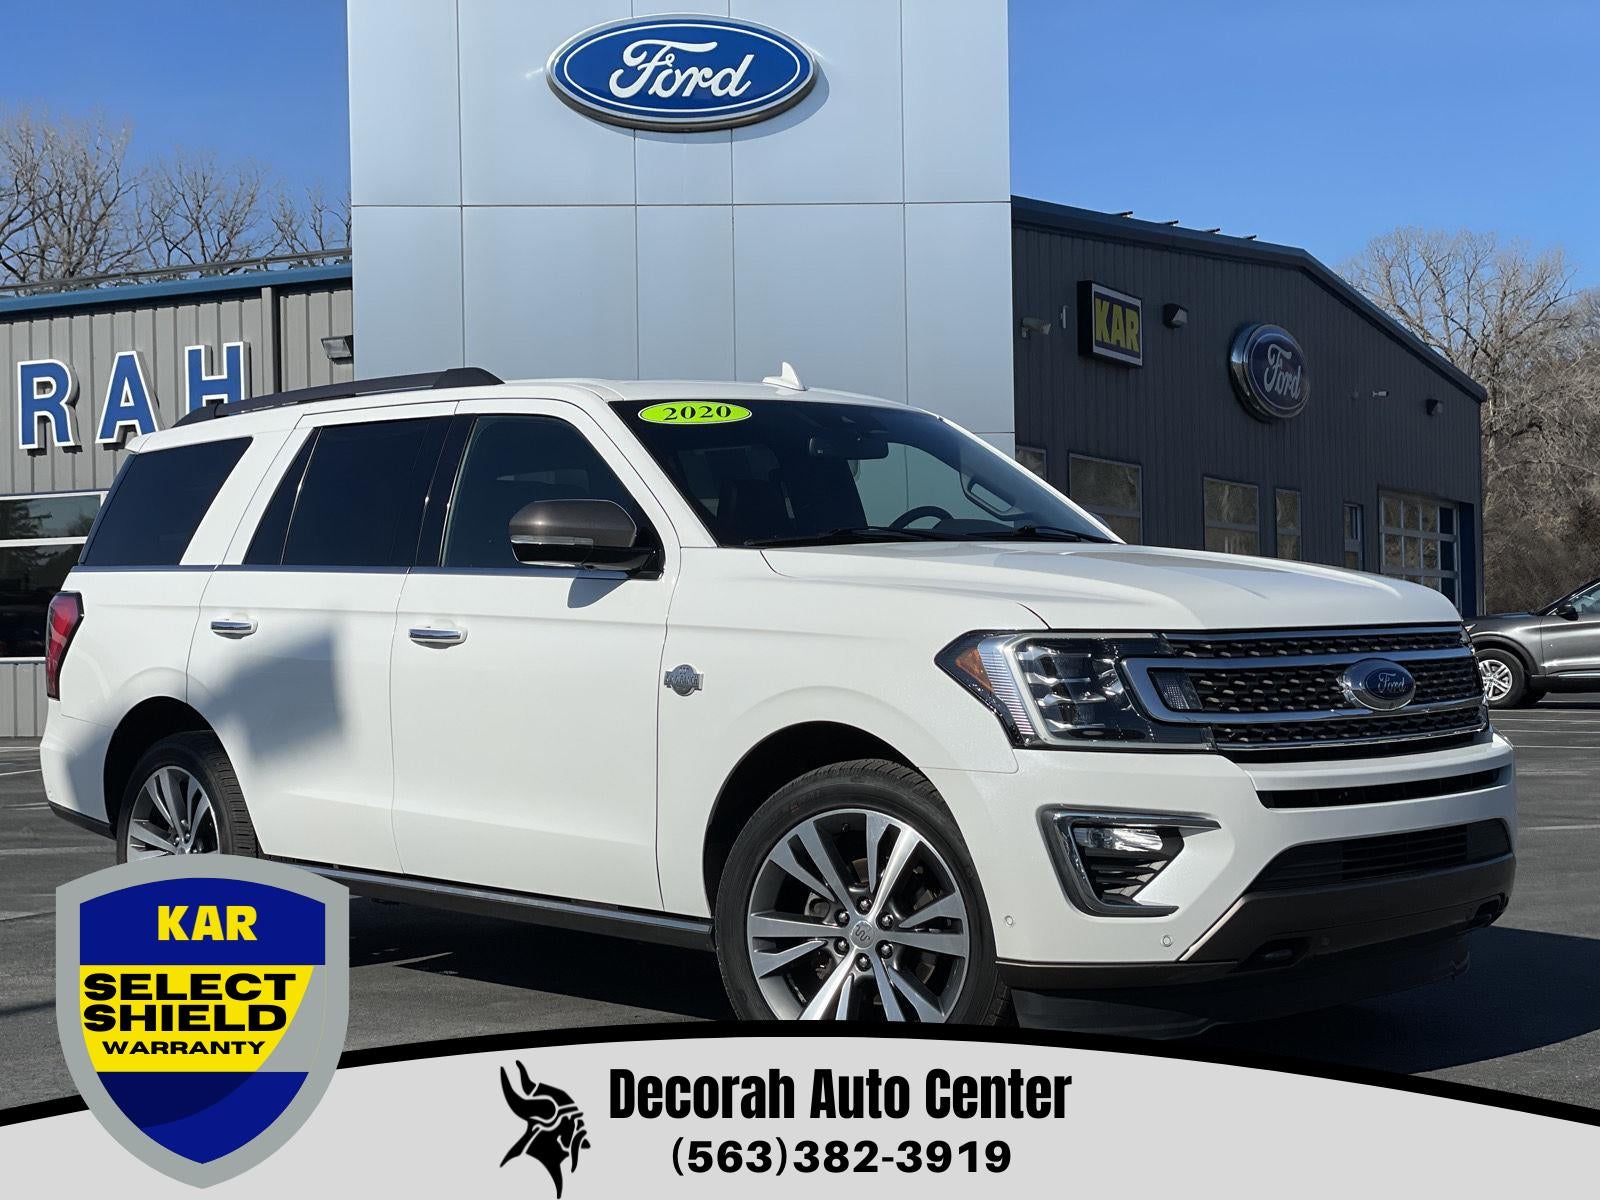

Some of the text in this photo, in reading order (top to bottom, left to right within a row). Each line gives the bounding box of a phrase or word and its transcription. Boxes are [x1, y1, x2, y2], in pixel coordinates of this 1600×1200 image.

[608, 39, 755, 98] Ford
[1094, 298, 1140, 353] KAR
[17, 342, 246, 450] RAH
[1263, 343, 1304, 400] Ford
[662, 405, 732, 421] 2020
[1377, 672, 1405, 693] Ford
